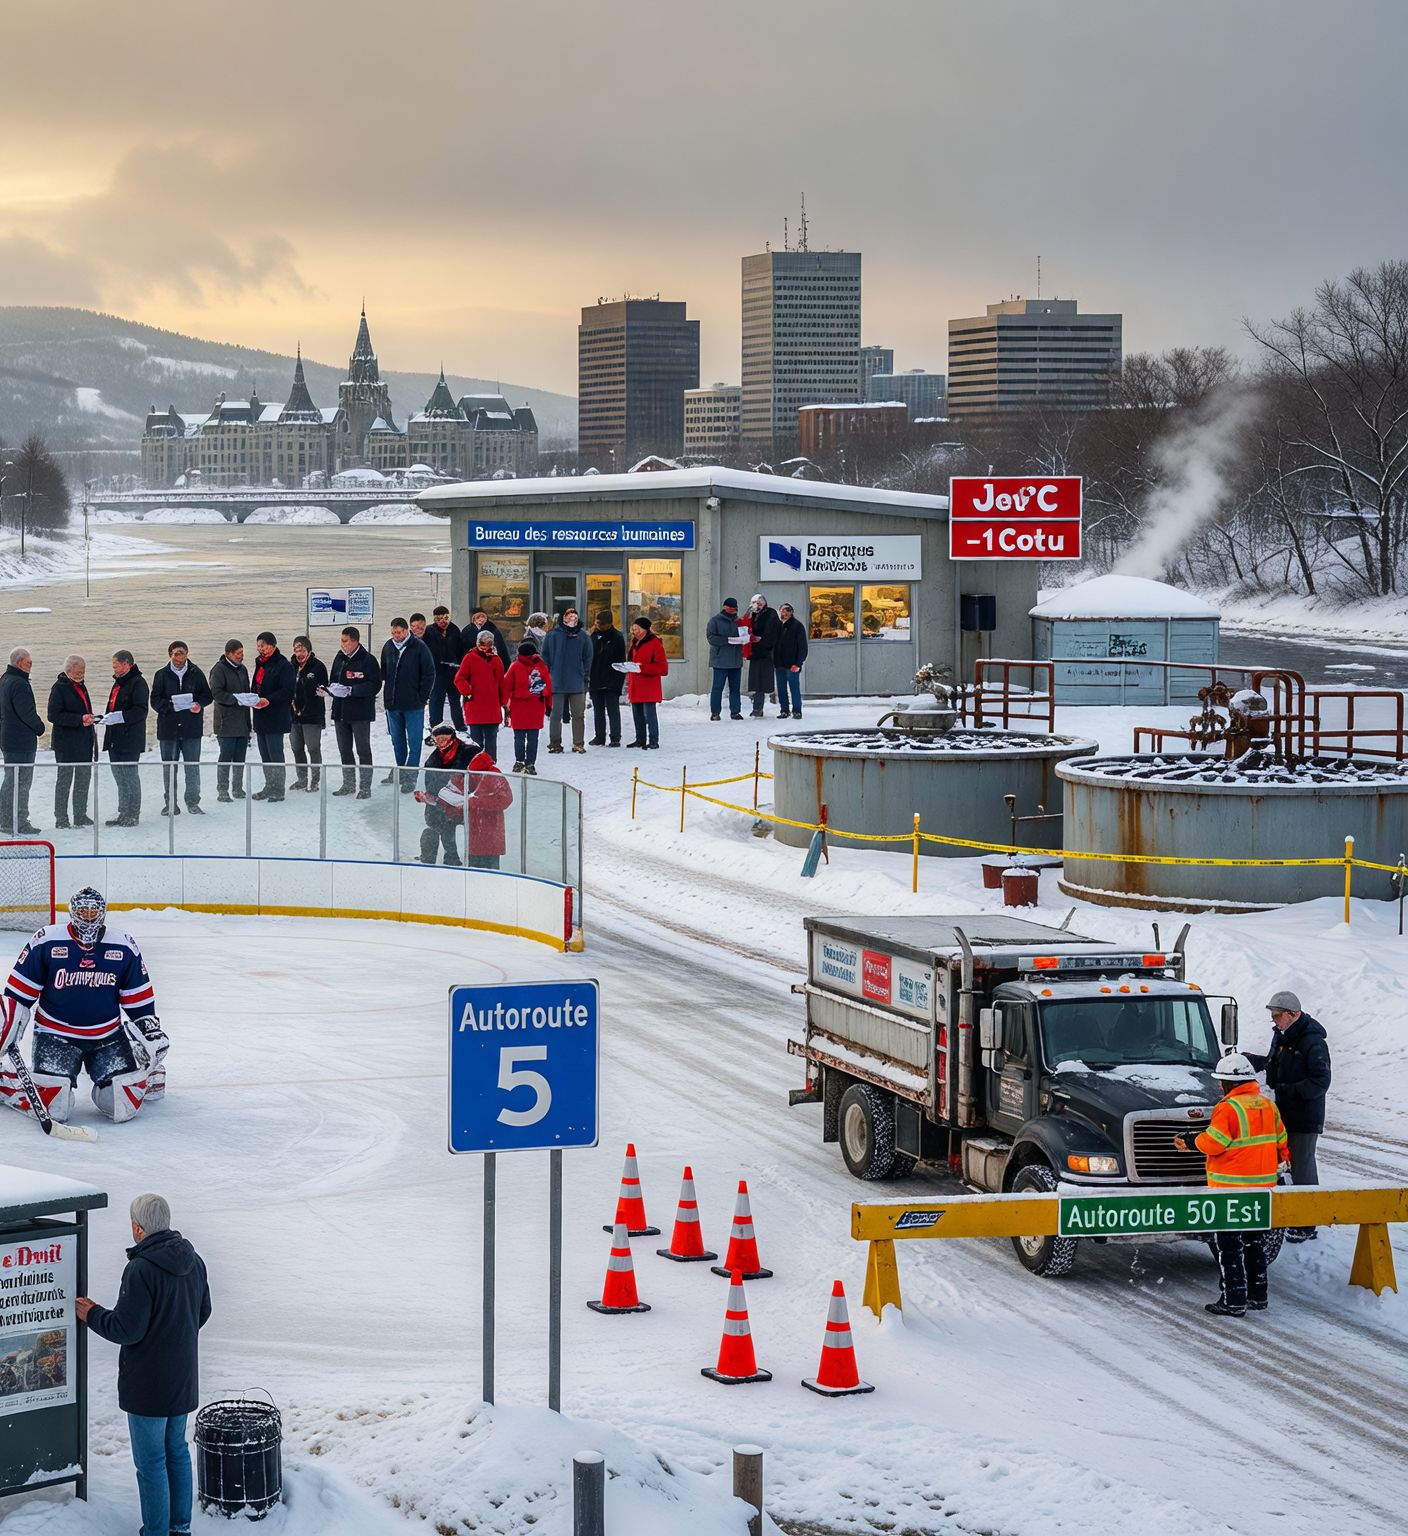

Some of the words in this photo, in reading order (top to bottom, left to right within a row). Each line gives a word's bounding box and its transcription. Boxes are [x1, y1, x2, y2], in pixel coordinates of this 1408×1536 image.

[475, 526, 520, 541] Bureau
[524, 526, 547, 541] des
[459, 998, 589, 1032] Autoroute
[496, 1045, 553, 1127] 5
[1067, 1203, 1175, 1228] Autoroute
[1187, 1200, 1216, 1225] 50
[1226, 1199, 1262, 1223] Est
